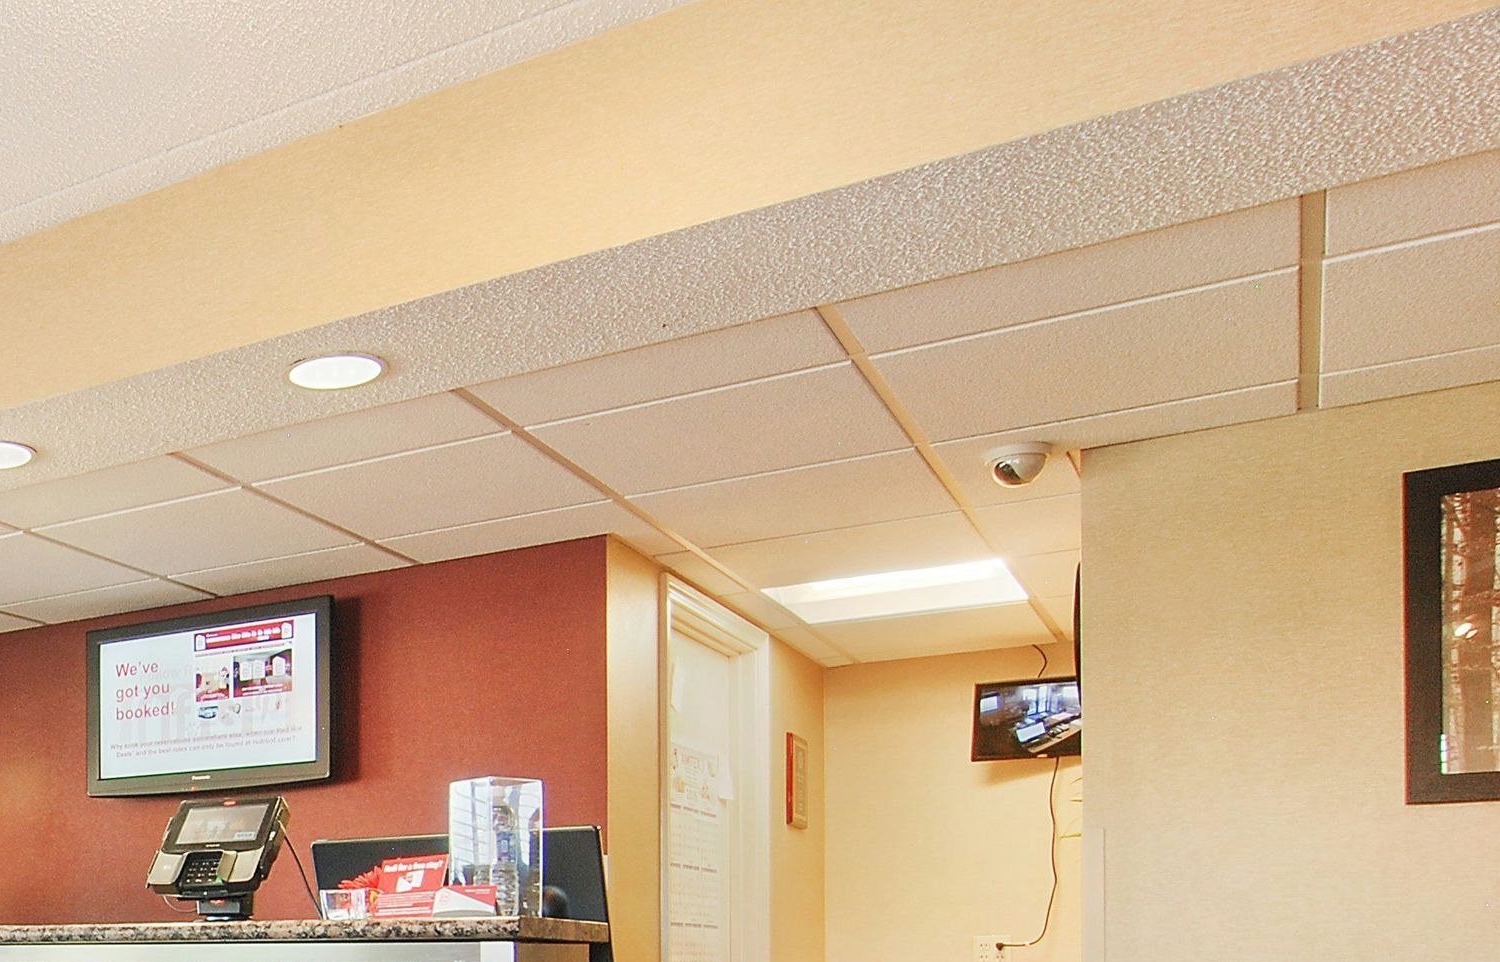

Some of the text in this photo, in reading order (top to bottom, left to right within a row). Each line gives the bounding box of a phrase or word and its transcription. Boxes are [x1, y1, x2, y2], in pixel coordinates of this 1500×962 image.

[115, 661, 159, 677] We've
[115, 683, 170, 703] got you
[115, 701, 174, 720] booked!
